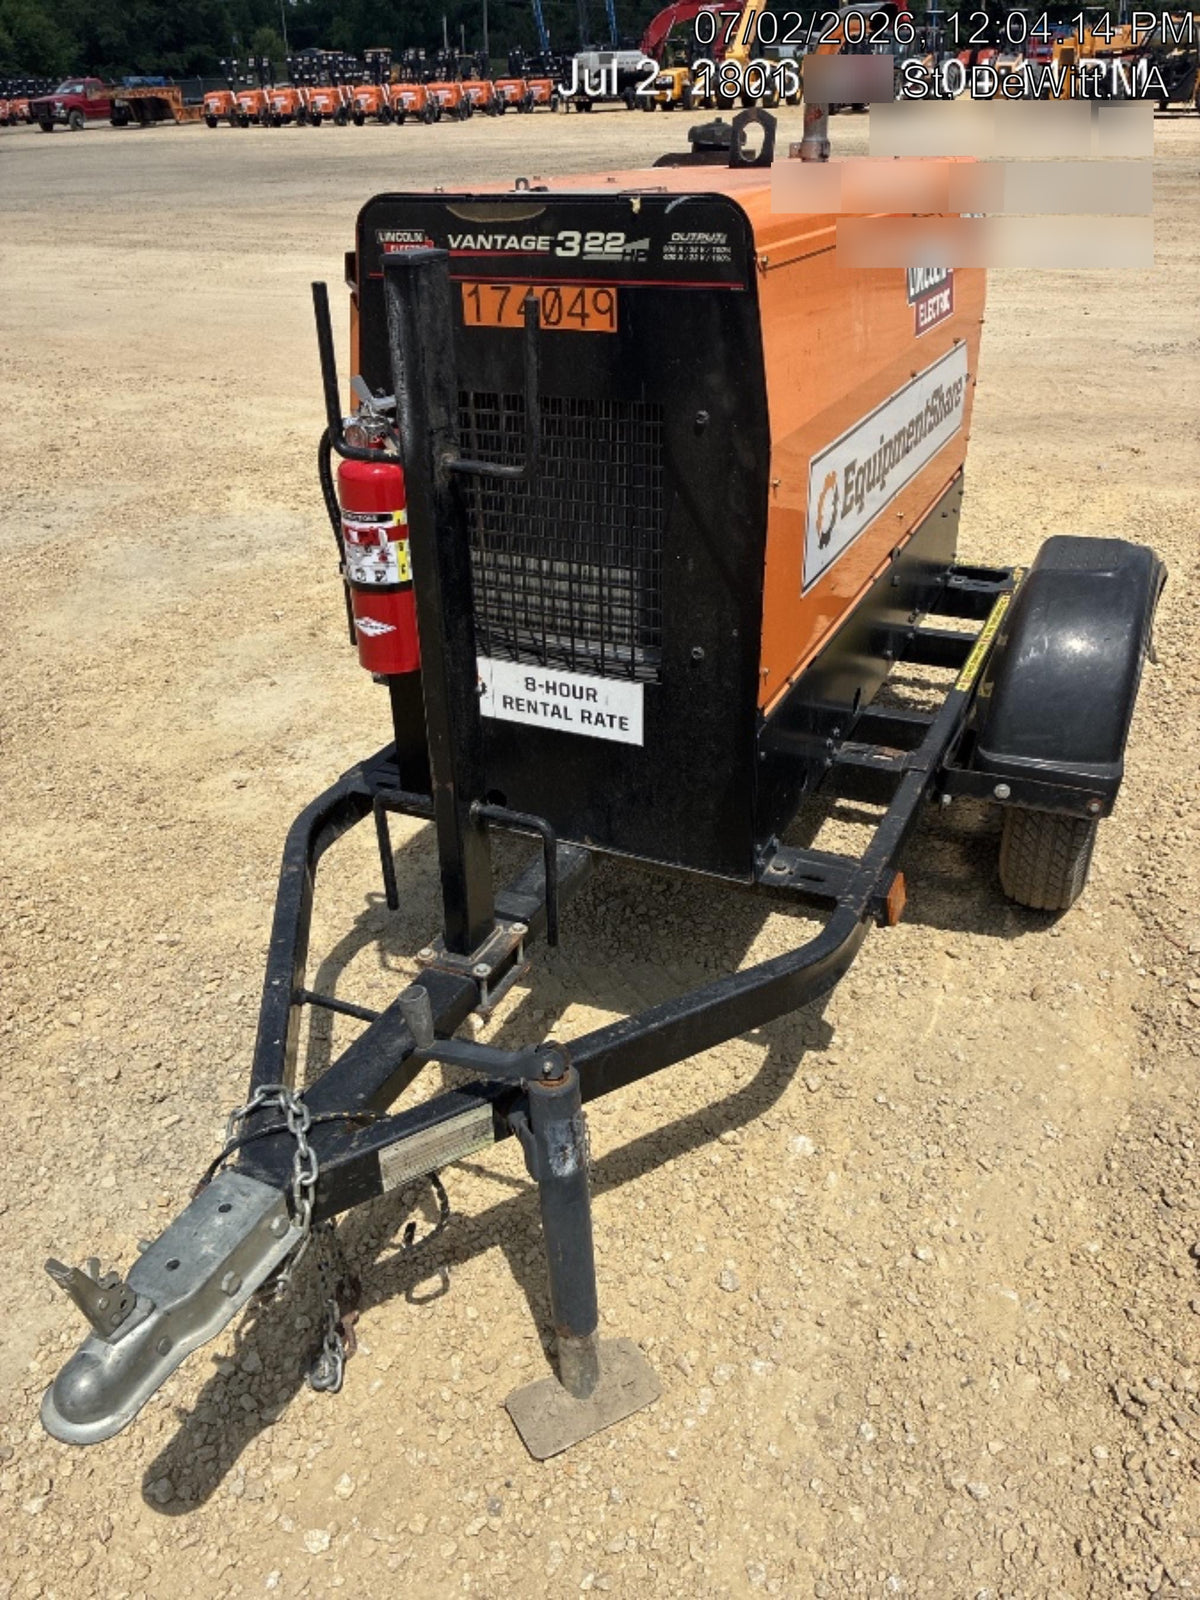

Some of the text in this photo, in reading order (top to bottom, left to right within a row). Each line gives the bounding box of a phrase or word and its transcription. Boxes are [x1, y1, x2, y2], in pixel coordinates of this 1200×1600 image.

[377, 231, 423, 243] LINCOLN
[447, 233, 551, 251] VANTAGE
[555, 230, 626, 257] 322
[918, 287, 951, 328] ELECTRIC
[840, 375, 963, 520] EquipmentShare
[524, 676, 599, 703] 8-HOUR
[502, 694, 631, 732] RENTAL RATE
